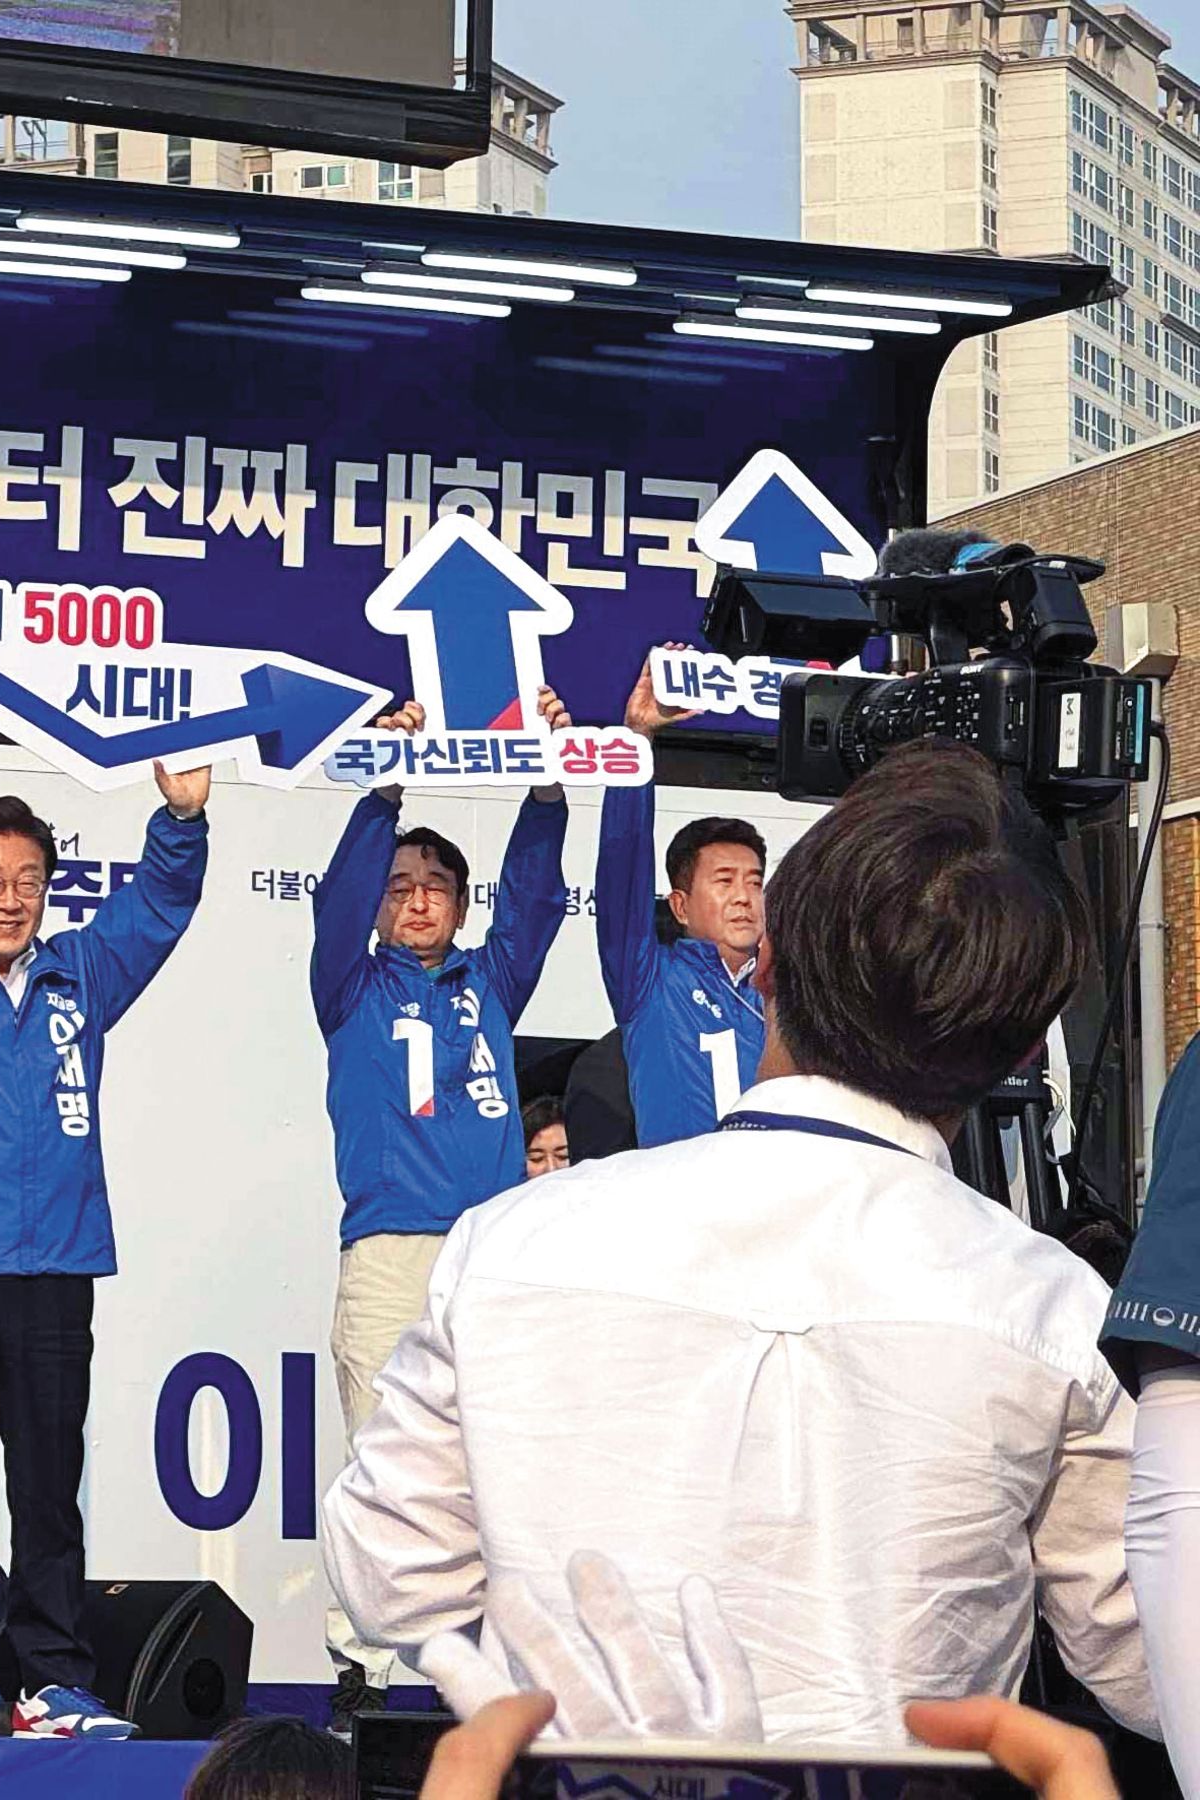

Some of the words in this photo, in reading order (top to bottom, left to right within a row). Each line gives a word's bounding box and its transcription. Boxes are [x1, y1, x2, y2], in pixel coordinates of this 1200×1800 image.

[107, 436, 317, 568] 진짜
[333, 453, 719, 598] 대한민국
[23, 591, 156, 650] 5000
[65, 665, 192, 721] 시대!
[663, 660, 738, 701] 내수
[334, 738, 546, 776] 국가신뢰도
[559, 738, 641, 774] 상승
[49, 1011, 90, 1137] 이재명
[392, 1018, 434, 1117] 1
[699, 1028, 742, 1123] 1
